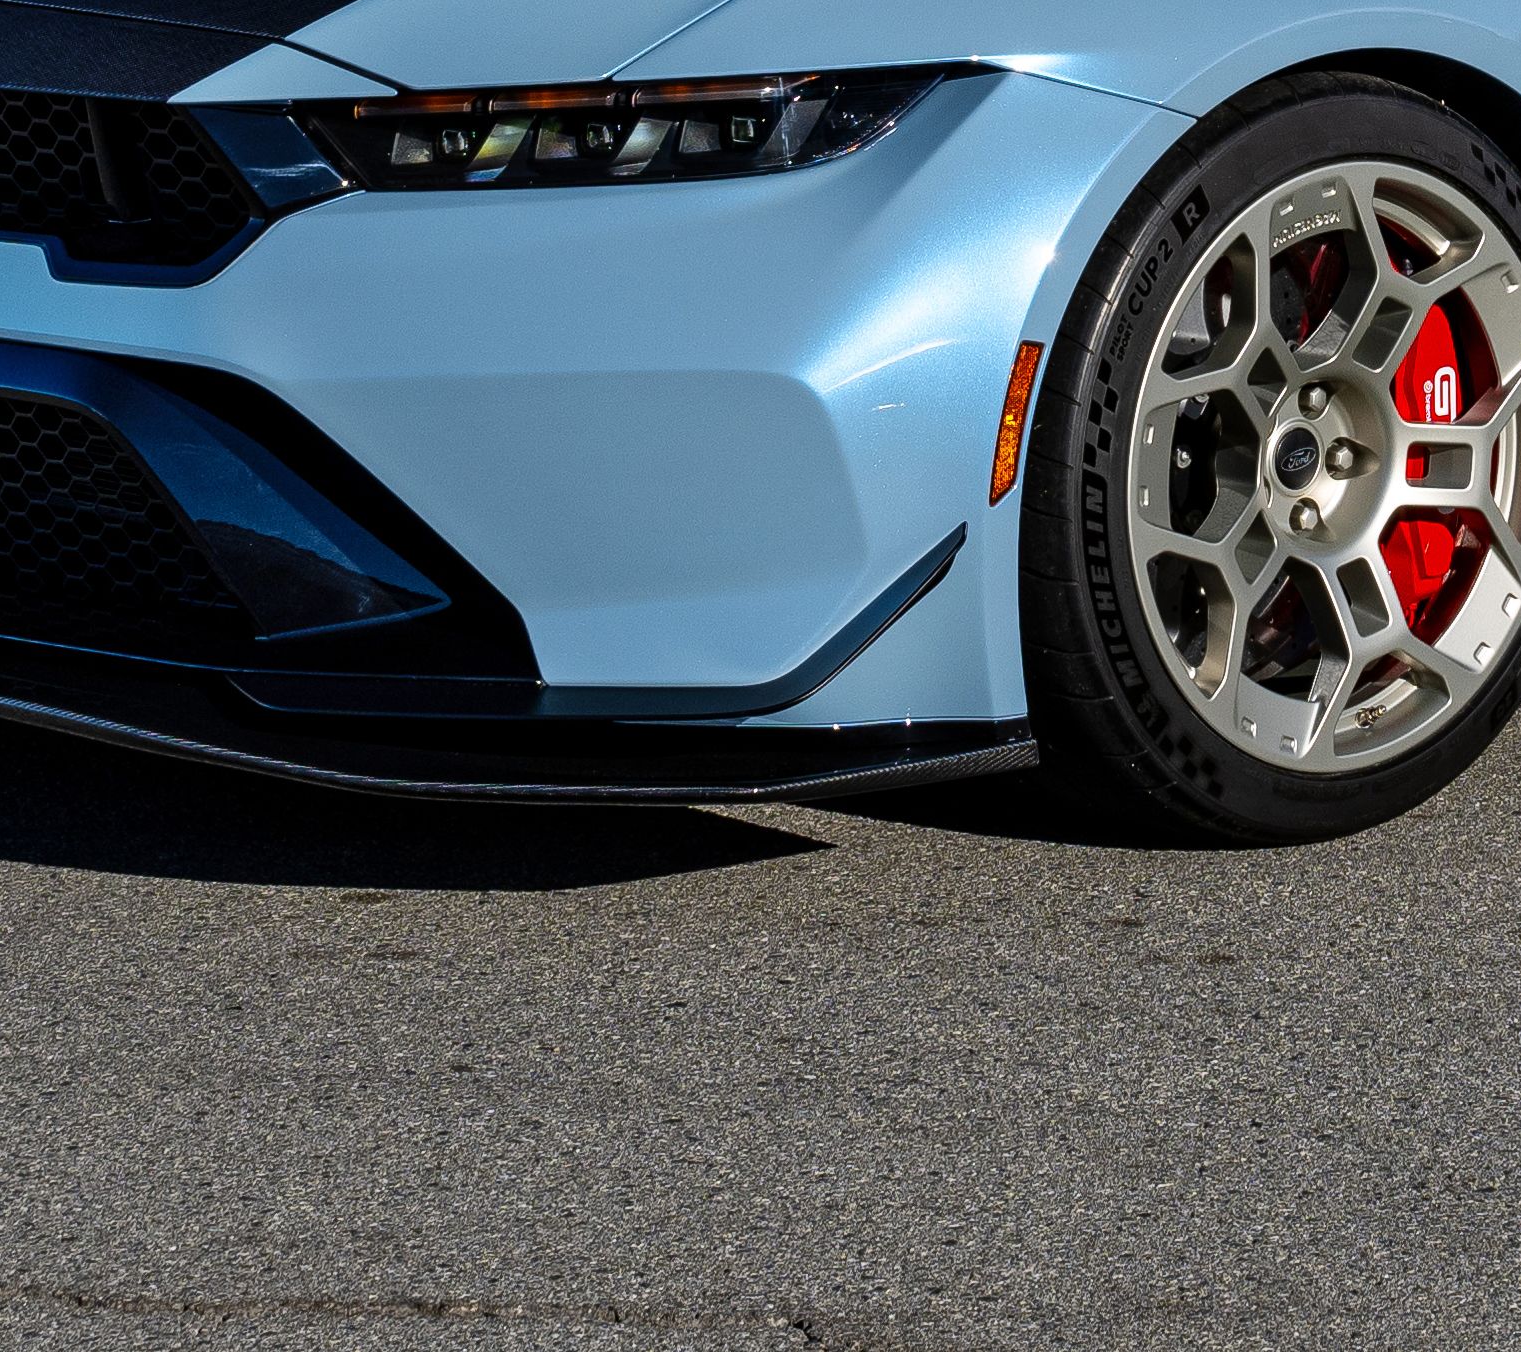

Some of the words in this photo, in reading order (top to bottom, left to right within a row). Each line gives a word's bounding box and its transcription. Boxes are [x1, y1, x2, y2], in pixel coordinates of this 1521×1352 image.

[1182, 202, 1200, 227] R
[1129, 256, 1159, 316] CUP
[1158, 238, 1174, 263] 2
[1109, 314, 1128, 357] PILOT
[1117, 325, 1135, 362] SPORT
[1084, 486, 1143, 688] MICHELIN
